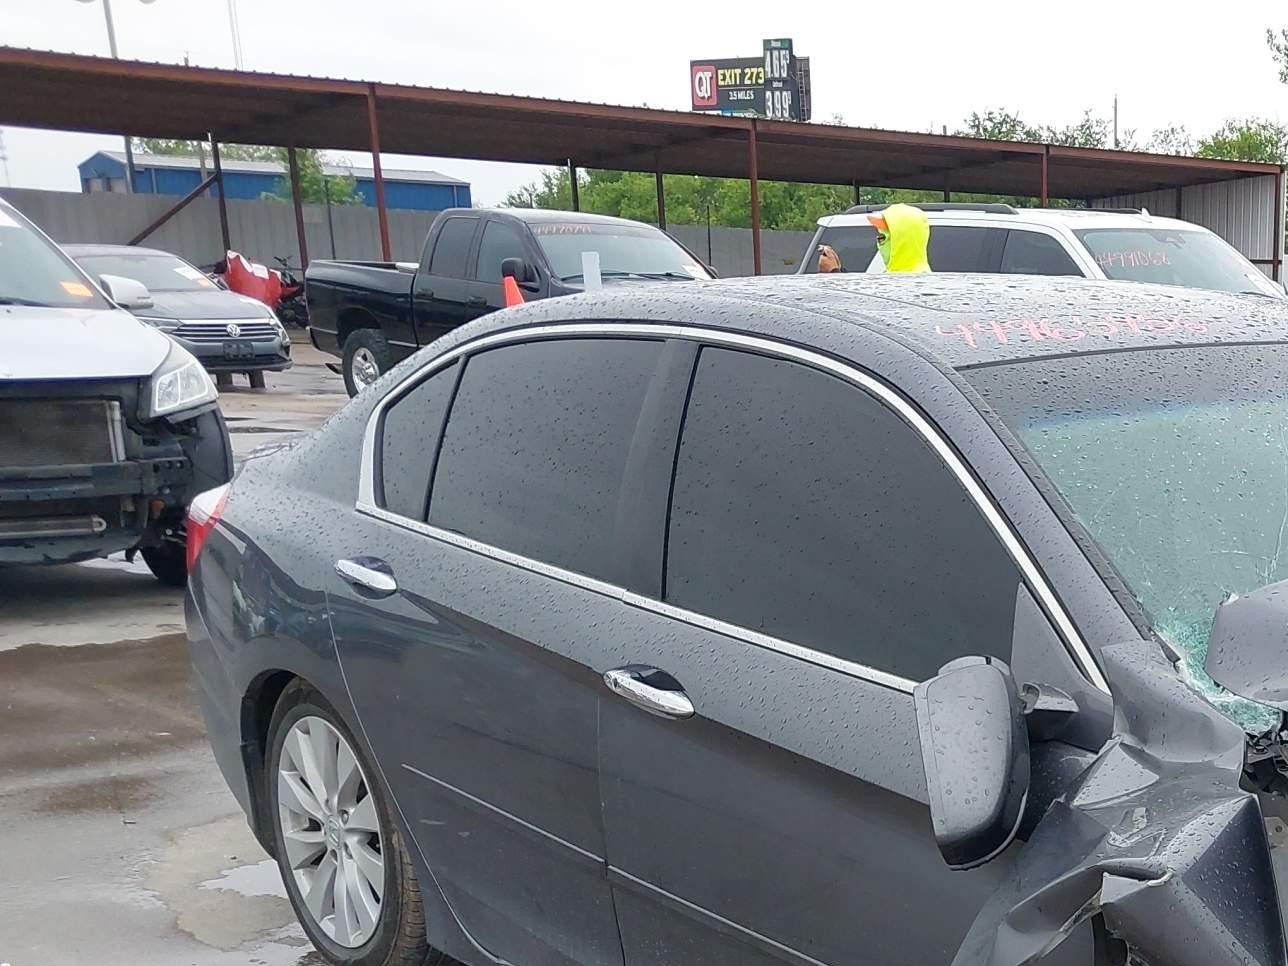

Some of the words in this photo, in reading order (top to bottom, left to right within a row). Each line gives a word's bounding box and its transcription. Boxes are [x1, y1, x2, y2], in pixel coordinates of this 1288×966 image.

[718, 69, 741, 85] EXIT
[744, 68, 764, 84] 273
[695, 71, 712, 100] QT
[738, 90, 754, 100] MILES
